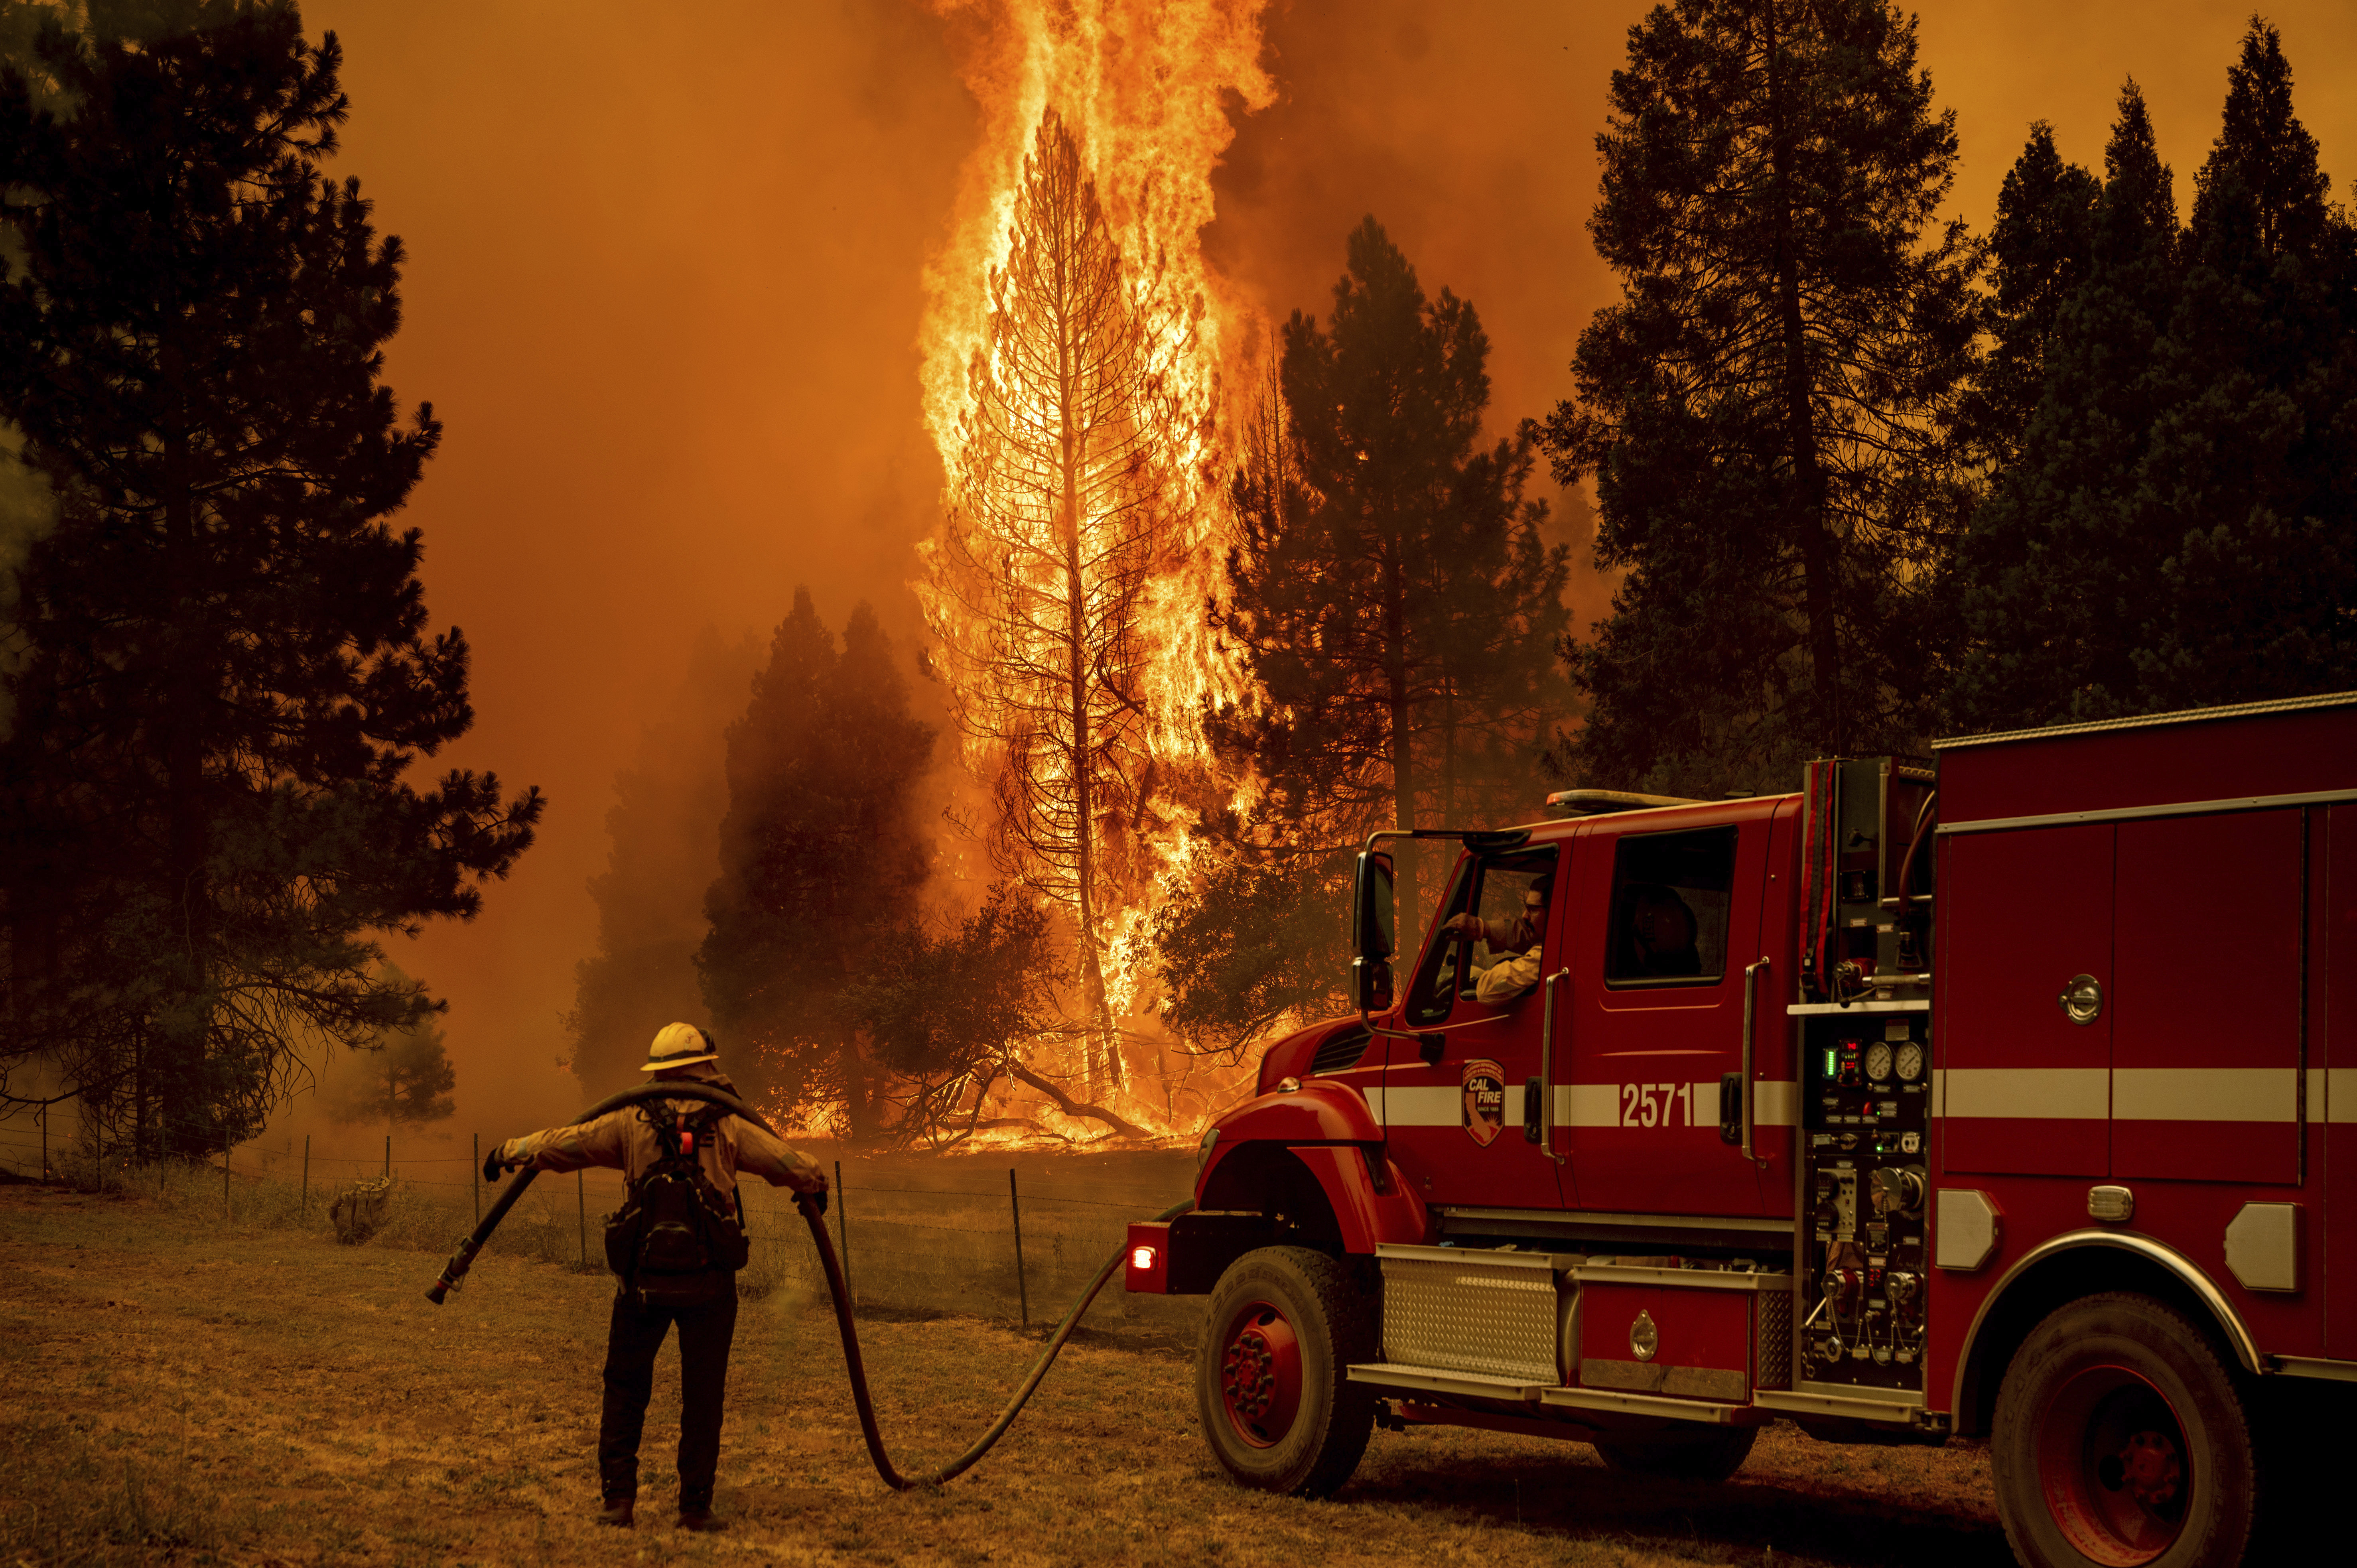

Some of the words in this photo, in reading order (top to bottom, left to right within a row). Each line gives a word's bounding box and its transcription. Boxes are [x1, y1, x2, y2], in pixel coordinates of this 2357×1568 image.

[1468, 1078, 1489, 1091] CAL
[1478, 1091, 1502, 1103] FIRE
[1622, 1082, 1691, 1128] 2571
